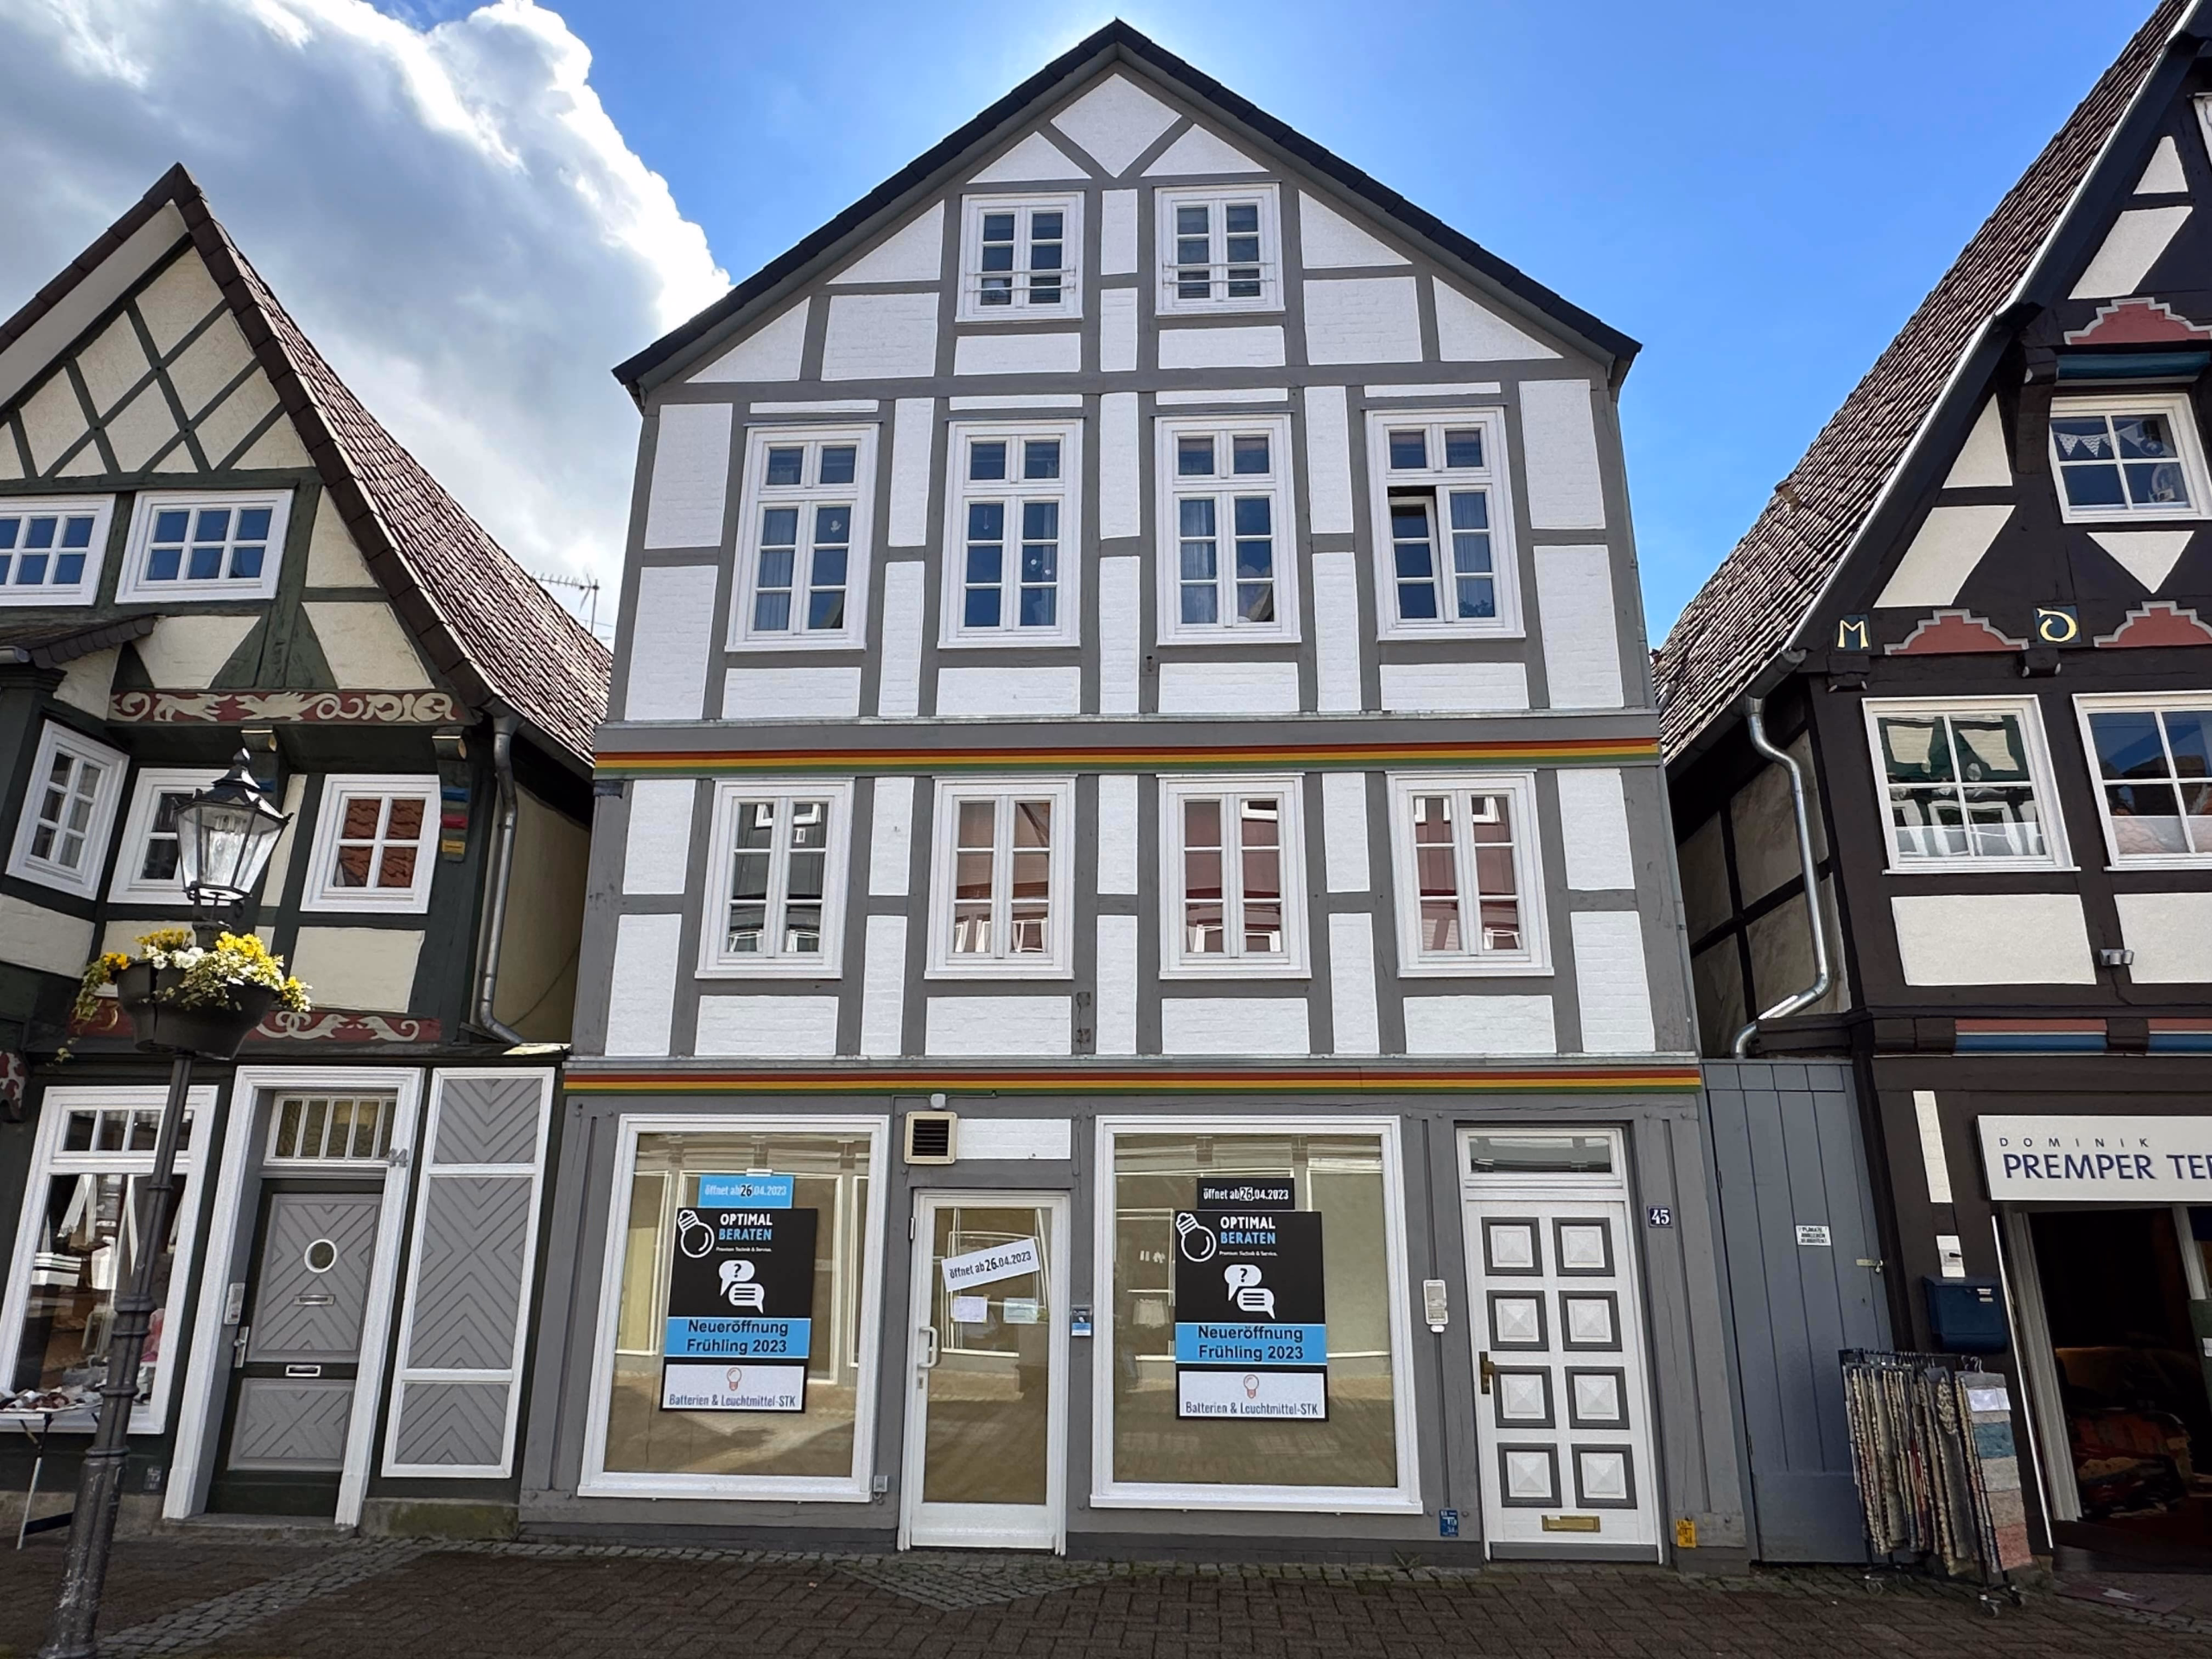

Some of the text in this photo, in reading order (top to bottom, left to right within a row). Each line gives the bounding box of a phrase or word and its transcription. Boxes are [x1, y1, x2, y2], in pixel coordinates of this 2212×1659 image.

[1837, 619, 1869, 648] M
[1999, 1137, 2149, 1147] DOMINIK
[2003, 1154, 2158, 1179] PREMPER
[705, 1184, 729, 1196] öffnet
[1203, 1187, 1289, 1201] öffnet ab 26.04.2023
[720, 1213, 772, 1226] OPTIMAL
[1220, 1216, 1275, 1230] OPTIMAL
[1651, 1209, 1669, 1224] 45
[718, 1229, 772, 1241] BERATEN
[1220, 1232, 1276, 1244] BERATEN
[949, 1250, 1032, 1280] öffnet ab 26.04.2023
[688, 1319, 789, 1337] Neueröffnung
[1198, 1325, 1303, 1343] Neueröffnung
[686, 1338, 787, 1356] Frühling 2023
[1198, 1344, 1304, 1362] Frühling 2023
[669, 1394, 709, 1406] Batterien
[711, 1395, 718, 1406] &
[1185, 1401, 1228, 1414] Batterien
[1230, 1402, 1237, 1414] &
